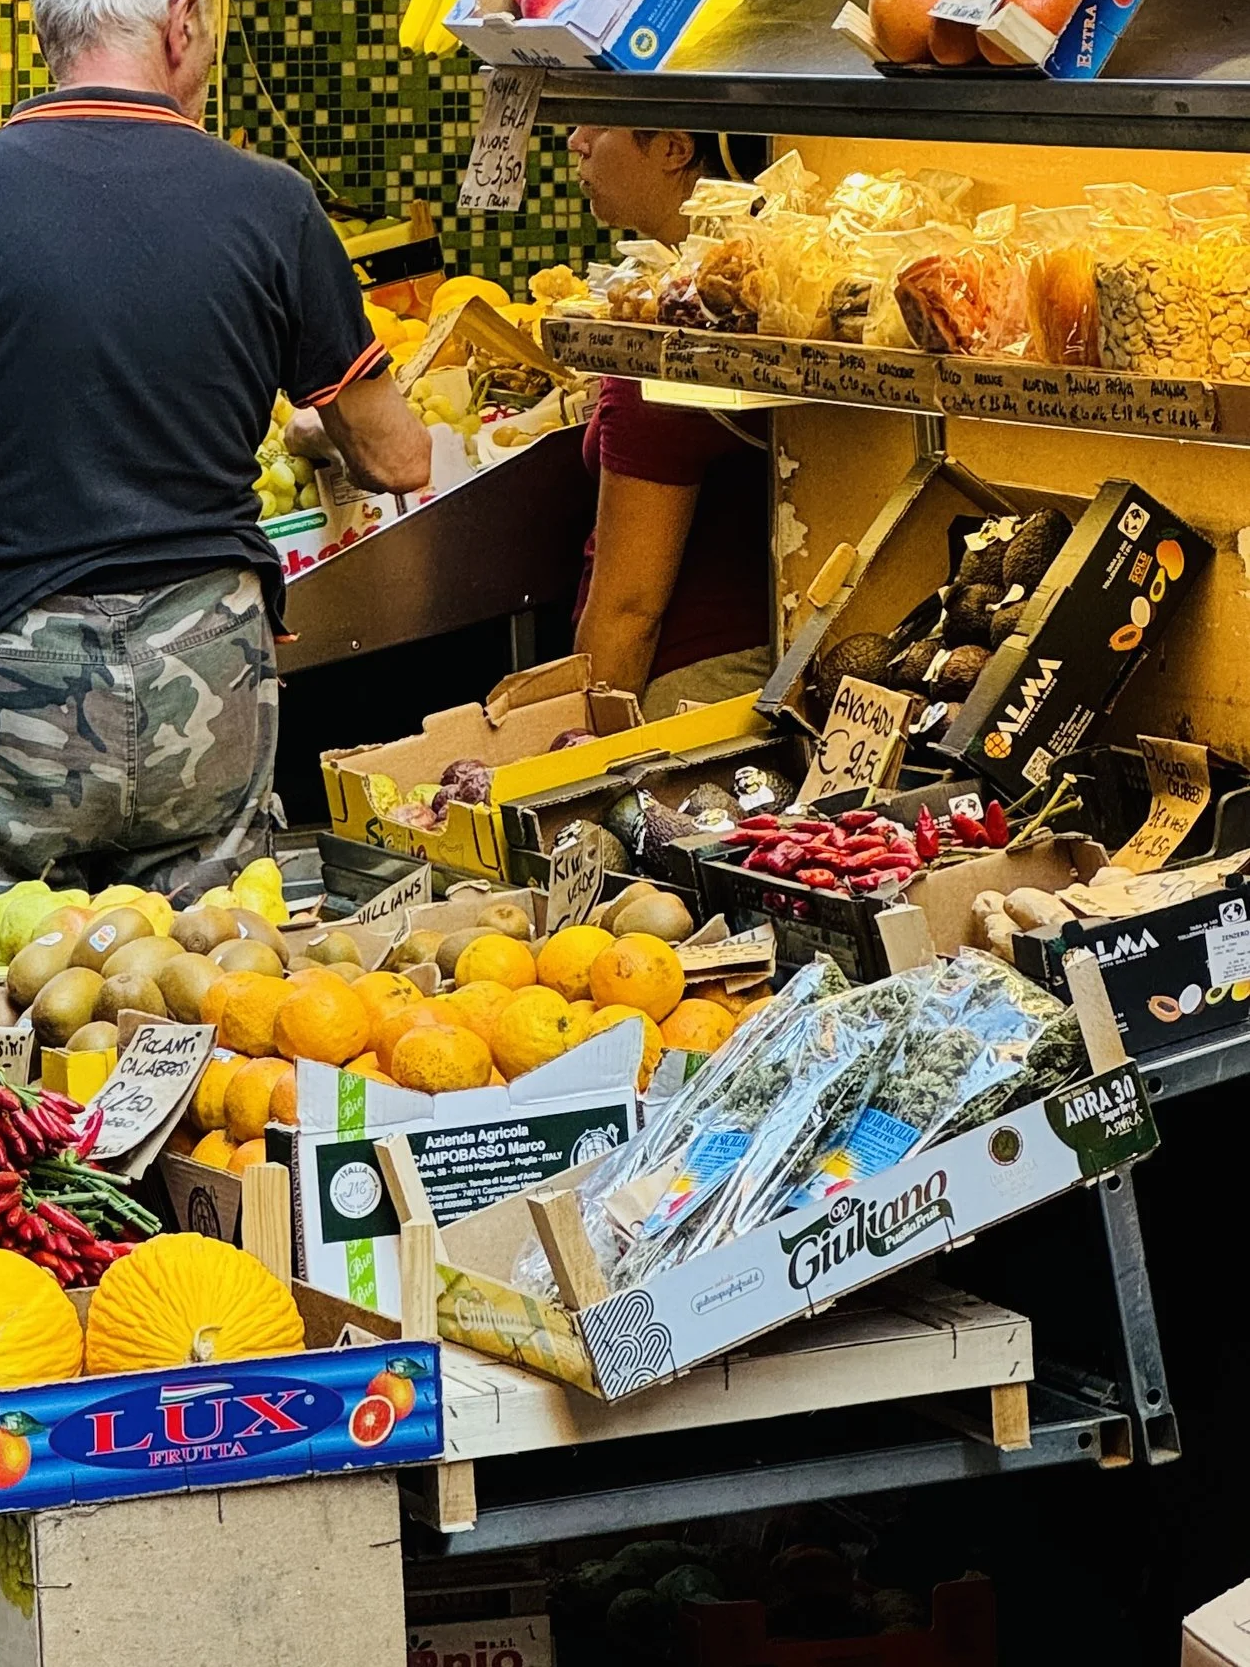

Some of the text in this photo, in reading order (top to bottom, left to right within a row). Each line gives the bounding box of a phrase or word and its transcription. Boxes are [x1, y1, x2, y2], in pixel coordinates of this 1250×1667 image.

[1077, 5, 1098, 69] EXTRA
[834, 687, 894, 738] AVOCADO
[132, 1028, 203, 1055] PICCANTI
[120, 1056, 197, 1078] CALABRESI
[1064, 1090, 1112, 1128] ARRA
[1112, 1075, 1137, 1109] 30
[425, 1124, 530, 1150] Azienda Agricola
[412, 1139, 547, 1168] CAMPOBASSO Marco
[542, 1152, 563, 1163] ITALY
[338, 1164, 369, 1179] ITALIA
[831, 1201, 850, 1222] op
[788, 1170, 948, 1291] Giuliano
[85, 1389, 309, 1457] LUX
[148, 1441, 248, 1467] FRUTTA
